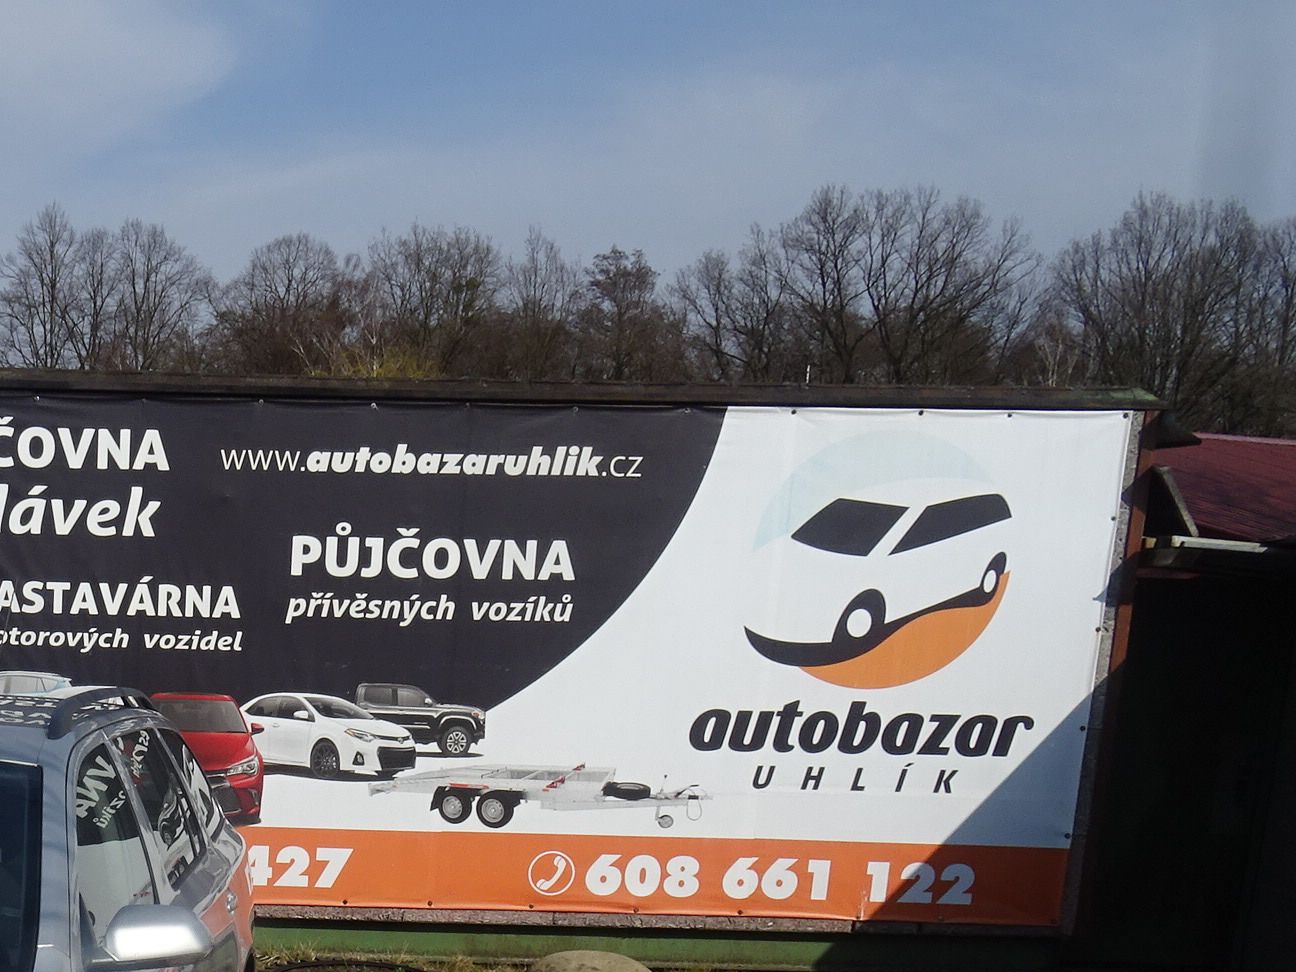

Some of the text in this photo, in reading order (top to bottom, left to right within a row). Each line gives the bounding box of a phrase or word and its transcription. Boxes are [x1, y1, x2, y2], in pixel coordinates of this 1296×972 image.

[220, 443, 643, 478] www.autobazaruhlik.cz
[290, 521, 575, 581] PŮJČOVNA
[284, 591, 574, 626] přívěsných vozíků
[143, 631, 243, 652] vozidel
[688, 700, 1034, 758] autobazar
[751, 763, 959, 794] UHLÍK
[584, 853, 976, 905] 608 661 122
